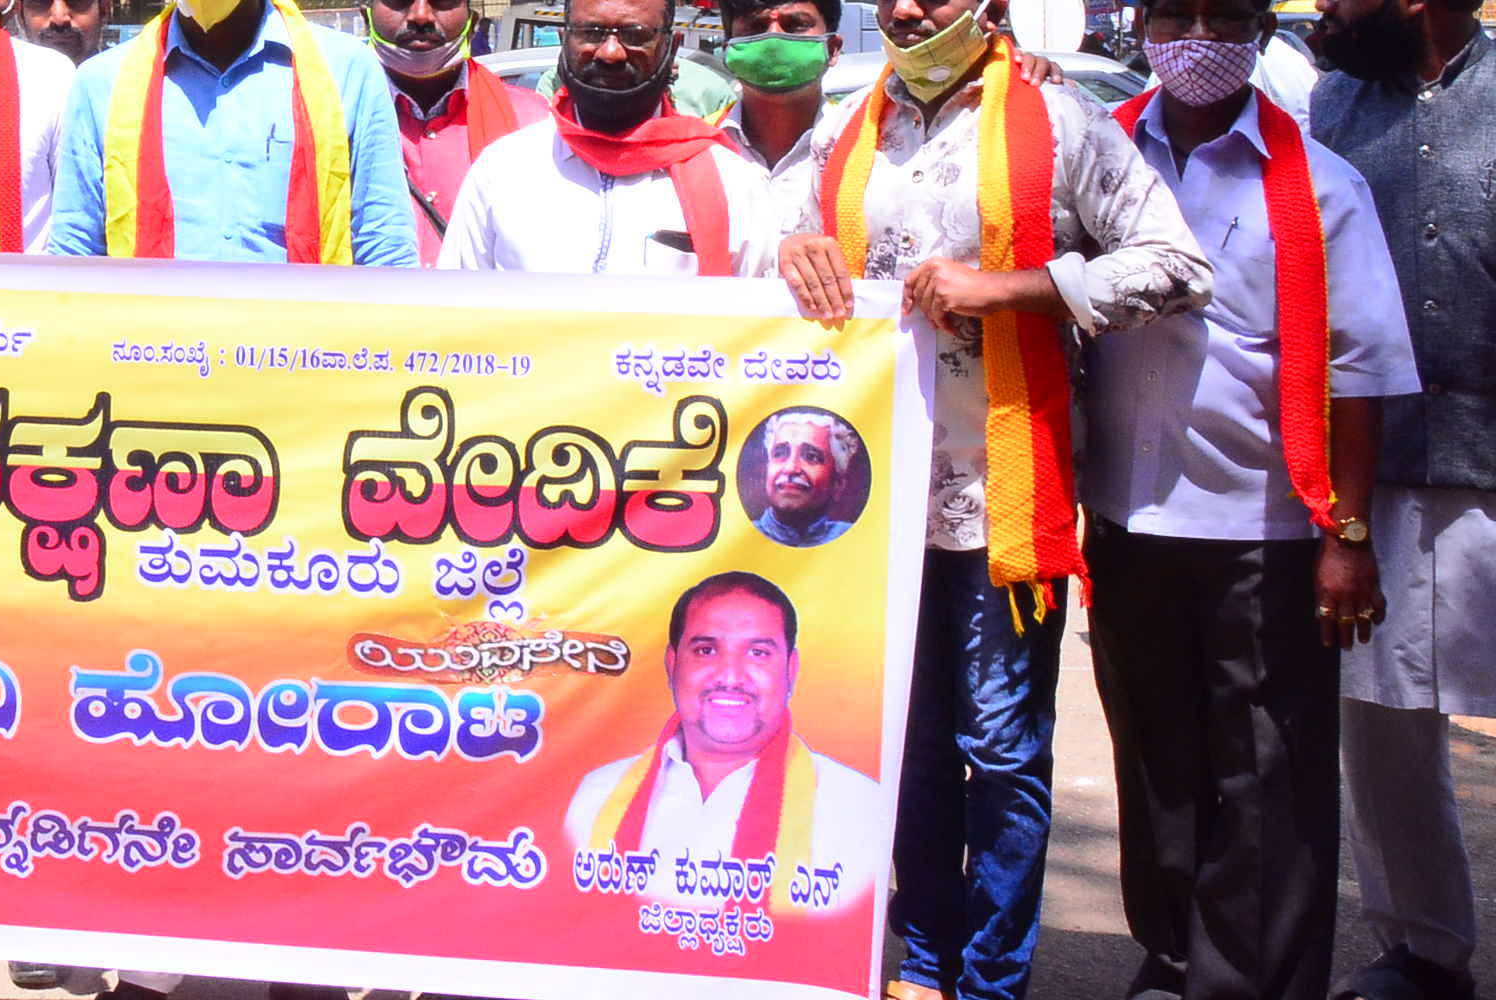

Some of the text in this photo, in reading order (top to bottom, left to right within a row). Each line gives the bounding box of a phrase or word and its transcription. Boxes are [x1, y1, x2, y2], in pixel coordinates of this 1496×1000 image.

[615, 349, 842, 392] ಕನ್ನಡವೇ ದೇವರು
[341, 385, 728, 553] ವೇದಿಕೆ
[138, 533, 526, 620] ತುಮಕೂರು ಜಿಲ್ಲೆ
[71, 650, 544, 761] ಹೋರಾಟ
[224, 825, 546, 886] ಸಾರ್ವಭೌಮ
[575, 845, 843, 907] ಅರುಣ್ ಕುಮಾರ್ ಎನ್
[639, 904, 772, 954] ಜಿಲ್ಲಾಧ್ಯಕ್ಷರು
